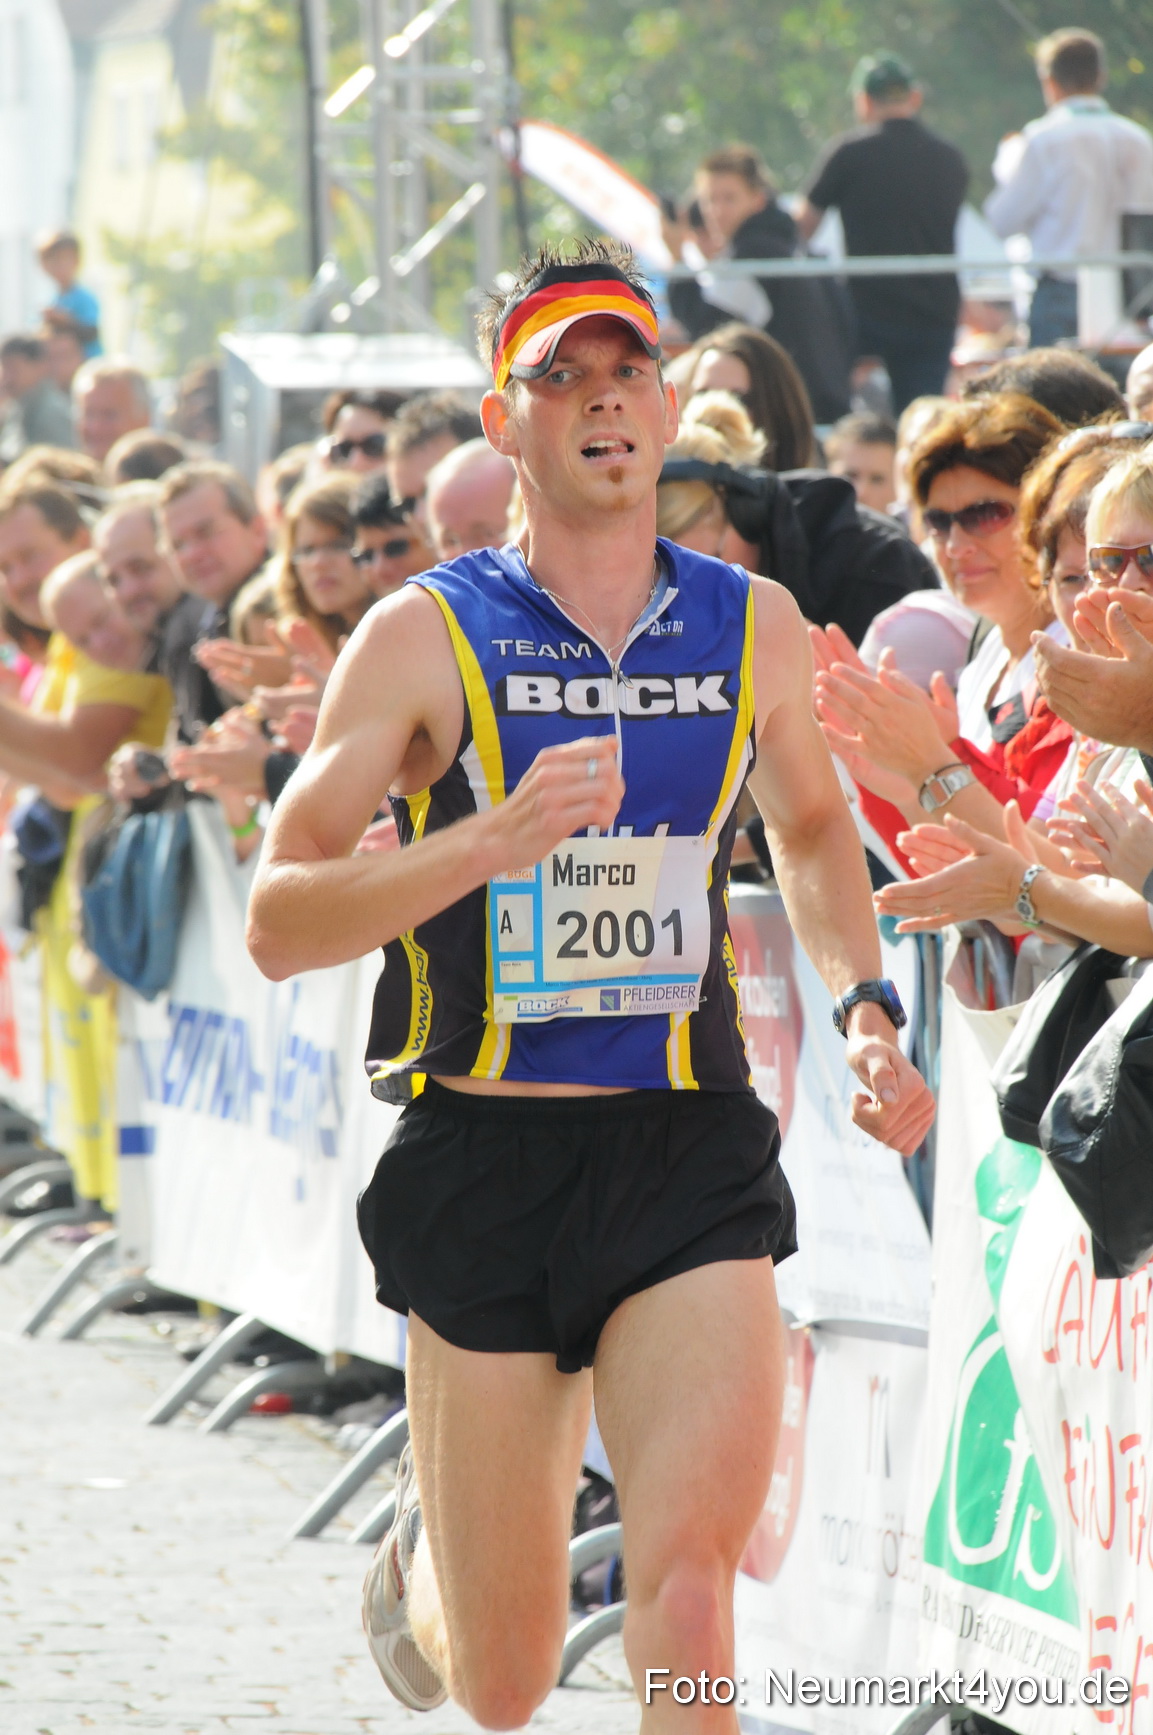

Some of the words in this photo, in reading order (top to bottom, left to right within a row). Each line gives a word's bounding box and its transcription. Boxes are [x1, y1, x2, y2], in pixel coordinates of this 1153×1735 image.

[492, 639, 592, 659] TEAM
[501, 673, 736, 718] BOCK
[553, 854, 635, 886] Marco
[500, 909, 513, 933] A
[556, 909, 683, 959] 2001
[517, 996, 570, 1012] BOCK
[623, 985, 696, 1002] PFLEIDERER
